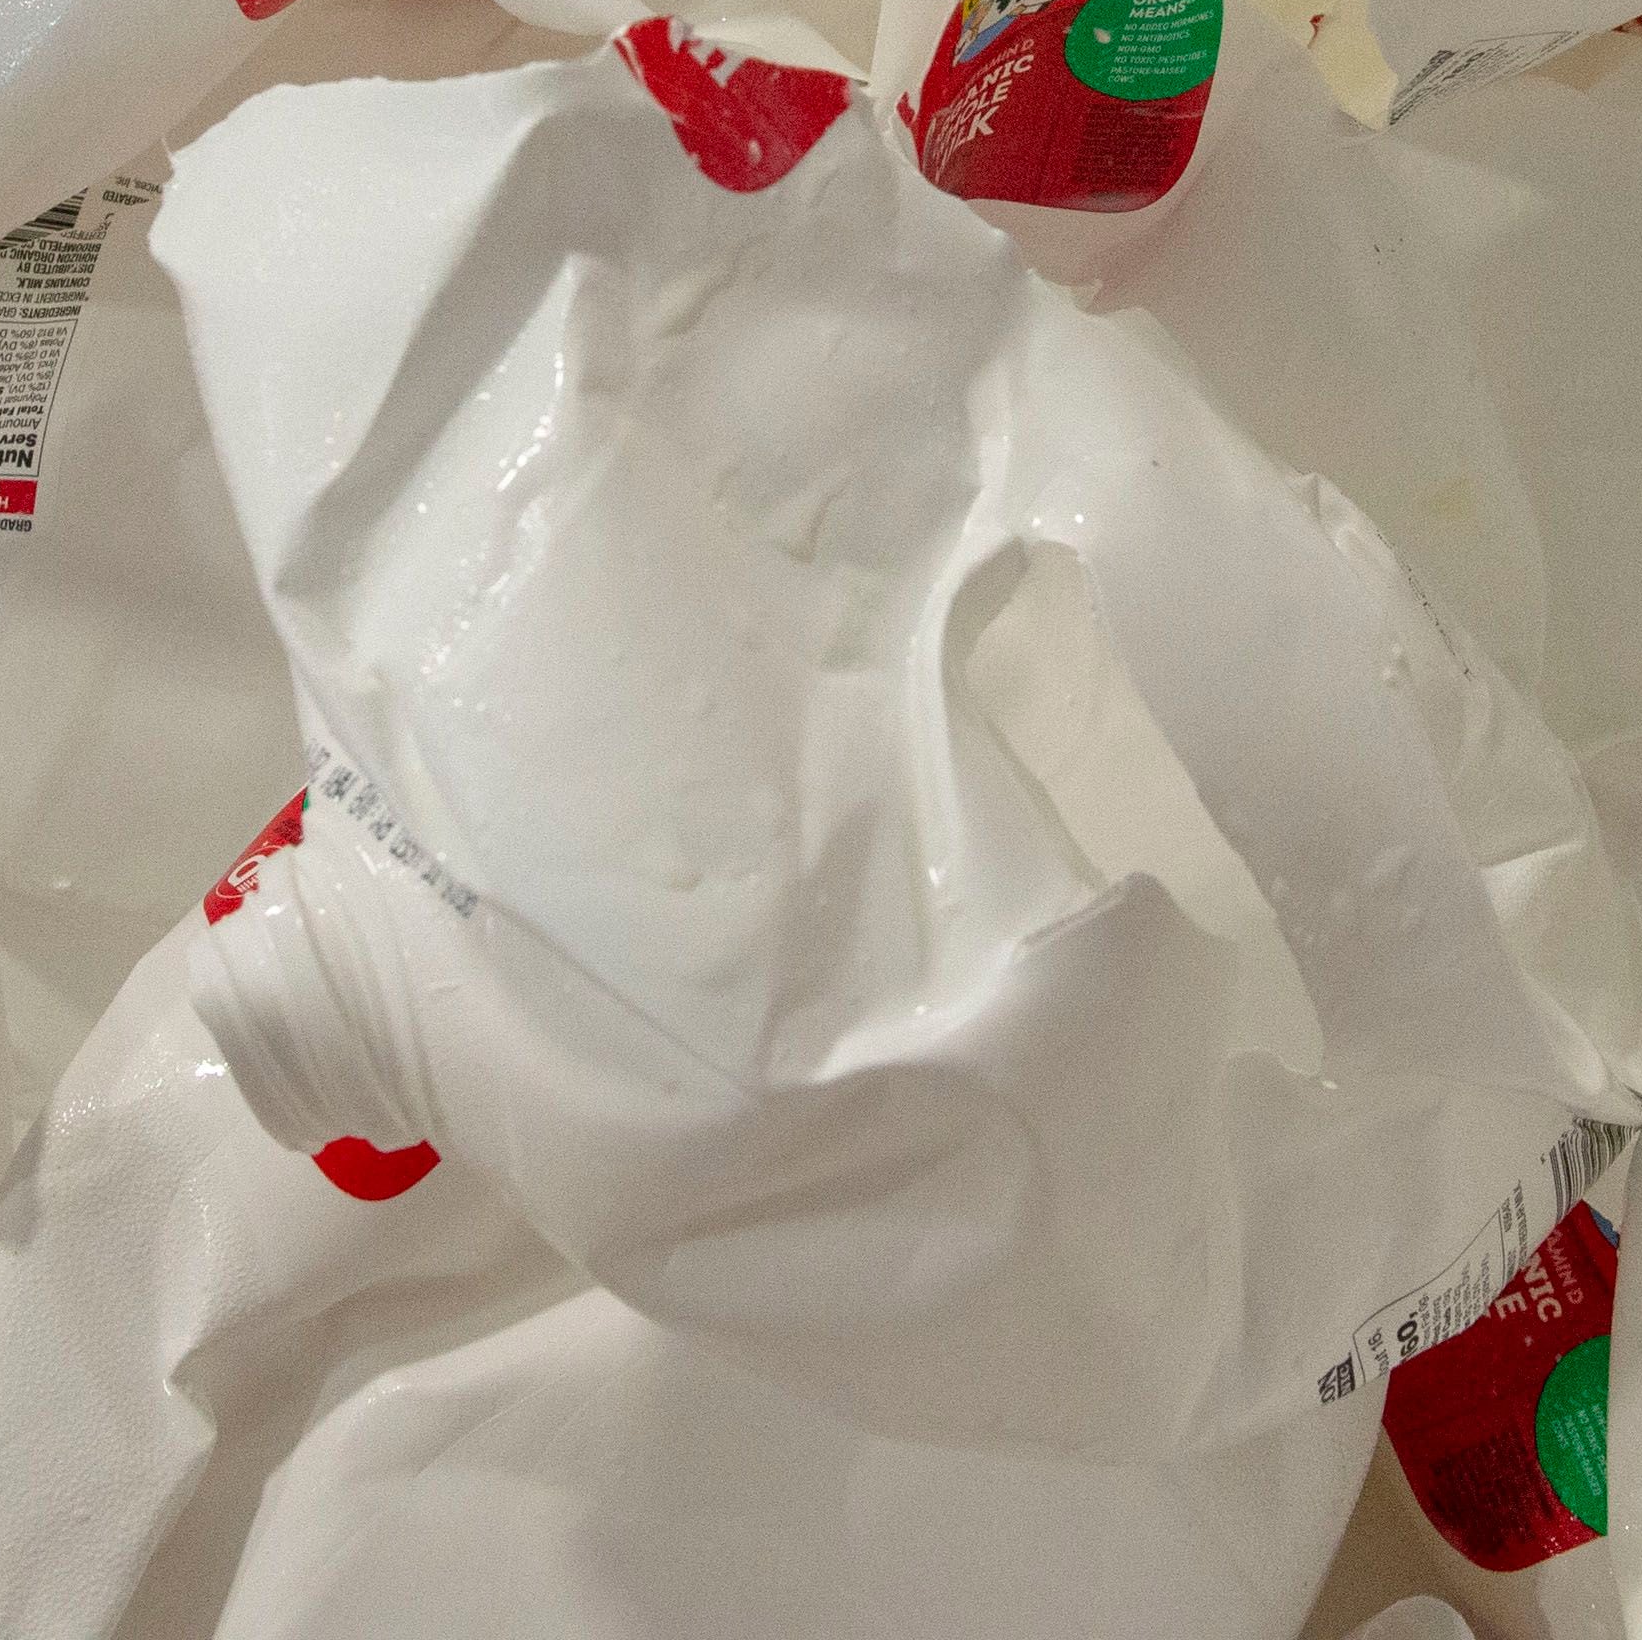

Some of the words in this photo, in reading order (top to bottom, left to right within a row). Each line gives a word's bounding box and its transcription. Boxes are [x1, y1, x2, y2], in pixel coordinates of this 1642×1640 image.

[7, 248, 56, 263] ORGANIC
[54, 252, 99, 264] HORIZON
[12, 277, 44, 287] MILK.
[42, 276, 91, 288] CONTAINS
[17, 305, 82, 316] INGREDIENTS:
